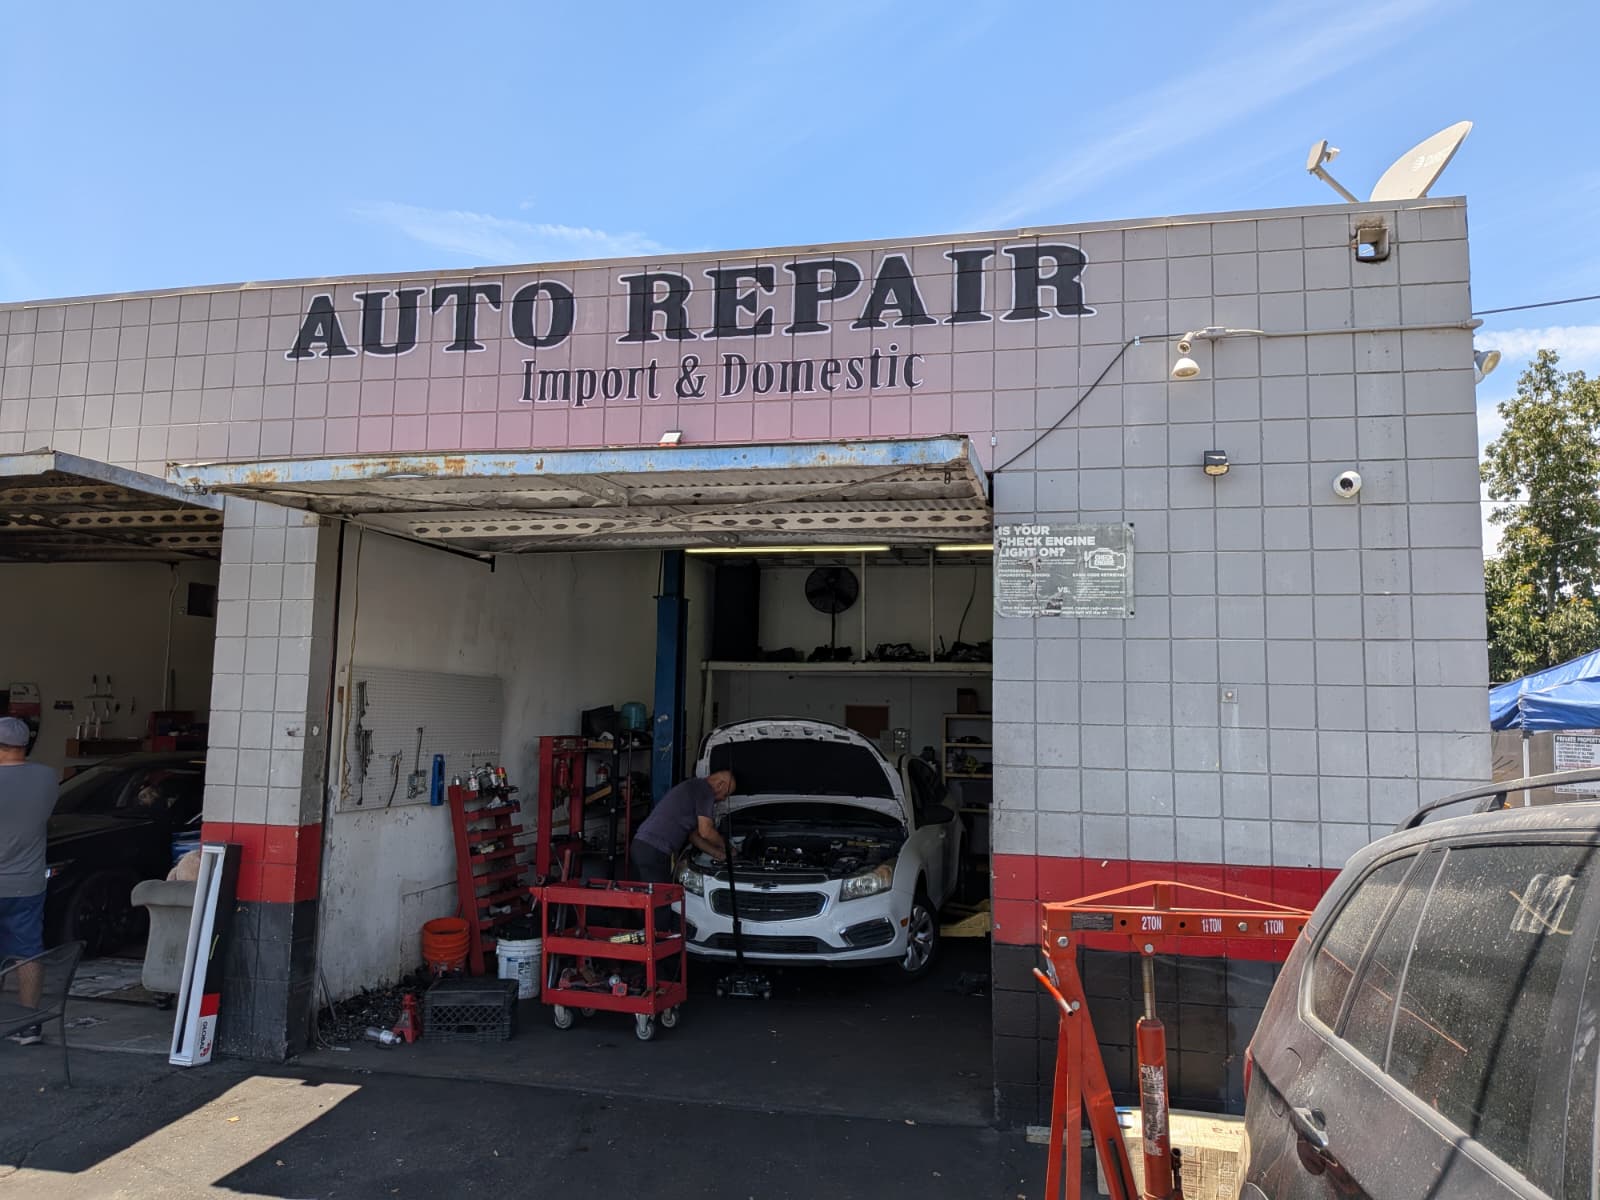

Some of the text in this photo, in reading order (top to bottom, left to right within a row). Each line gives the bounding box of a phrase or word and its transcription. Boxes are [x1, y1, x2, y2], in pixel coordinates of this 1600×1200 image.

[284, 243, 1097, 360] AUTO REPAIR
[520, 343, 925, 408] Import & Domestic
[998, 525, 1050, 536] IS YOUR
[1045, 536, 1096, 546] ENGINE
[999, 547, 1065, 558] LIGHT ON?
